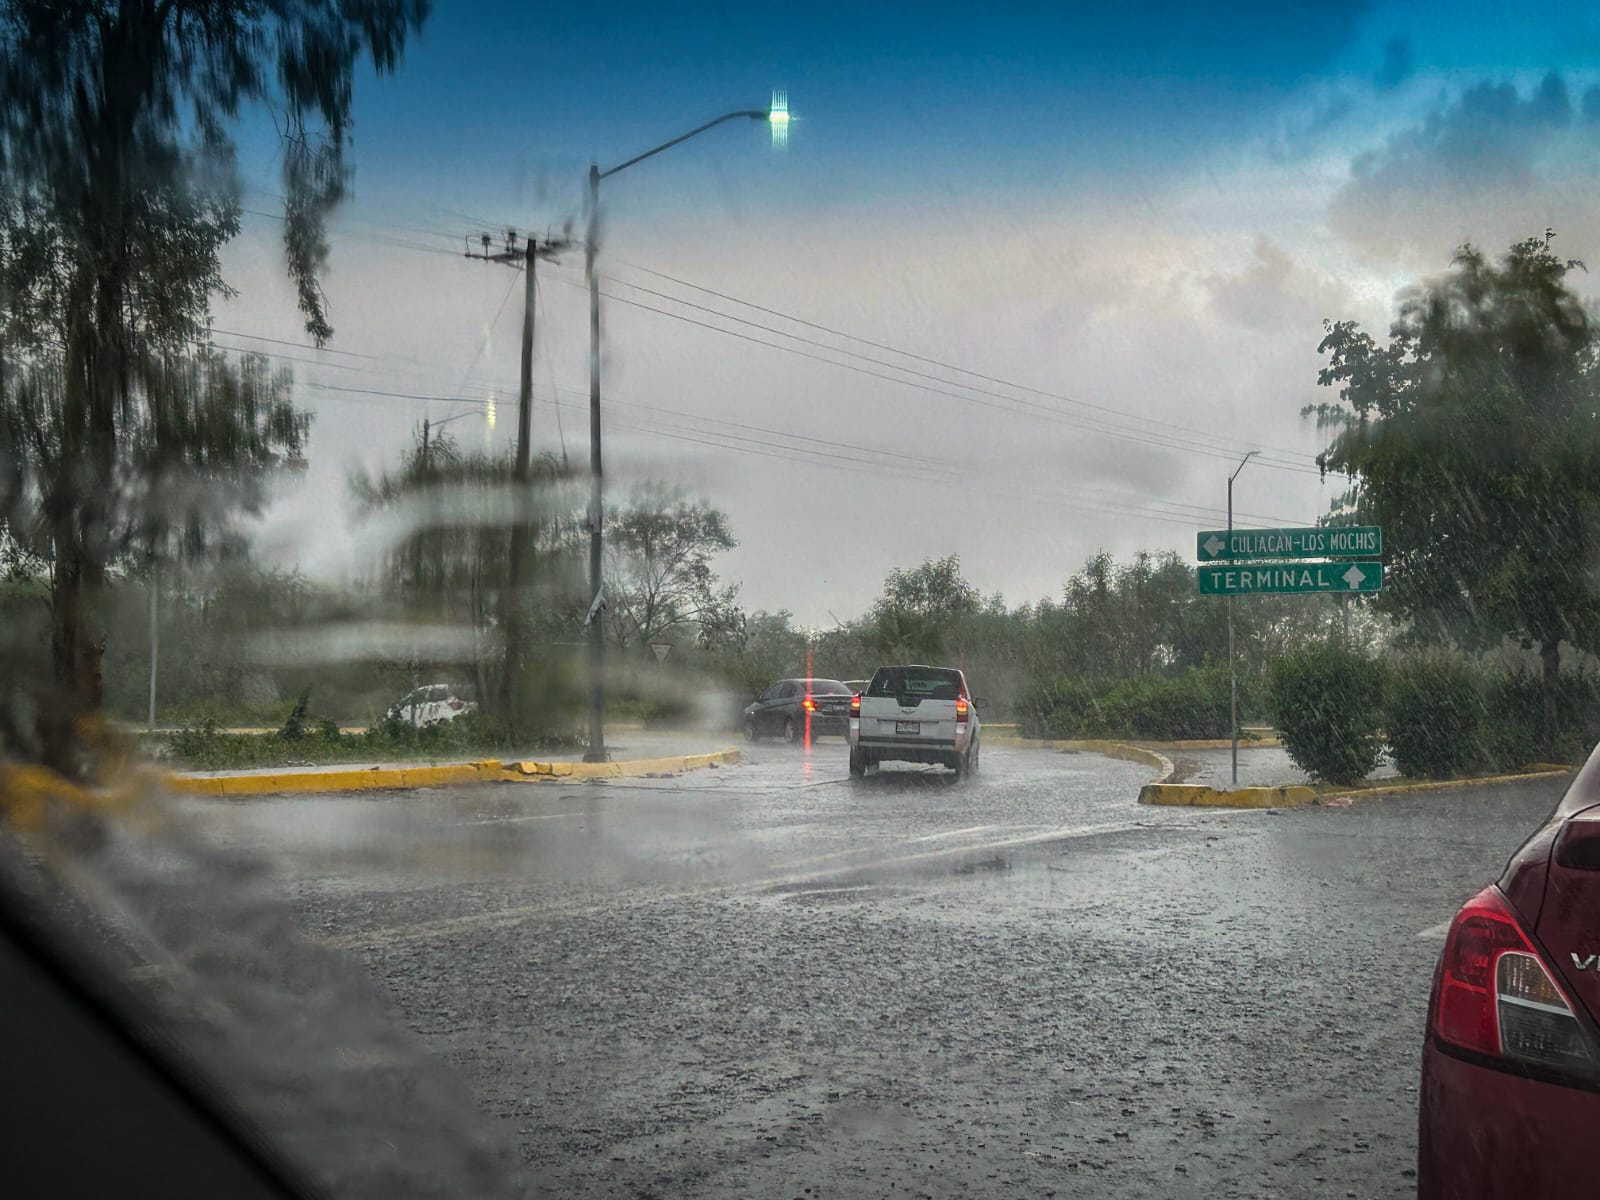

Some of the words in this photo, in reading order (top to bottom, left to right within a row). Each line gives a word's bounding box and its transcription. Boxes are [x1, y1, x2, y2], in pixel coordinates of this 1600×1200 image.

[1231, 535, 1325, 553] CULIACAN-LOS
[1330, 532, 1376, 550] MOCHIS
[1211, 569, 1329, 589] TERMINAL
[1571, 953, 1600, 971] V
